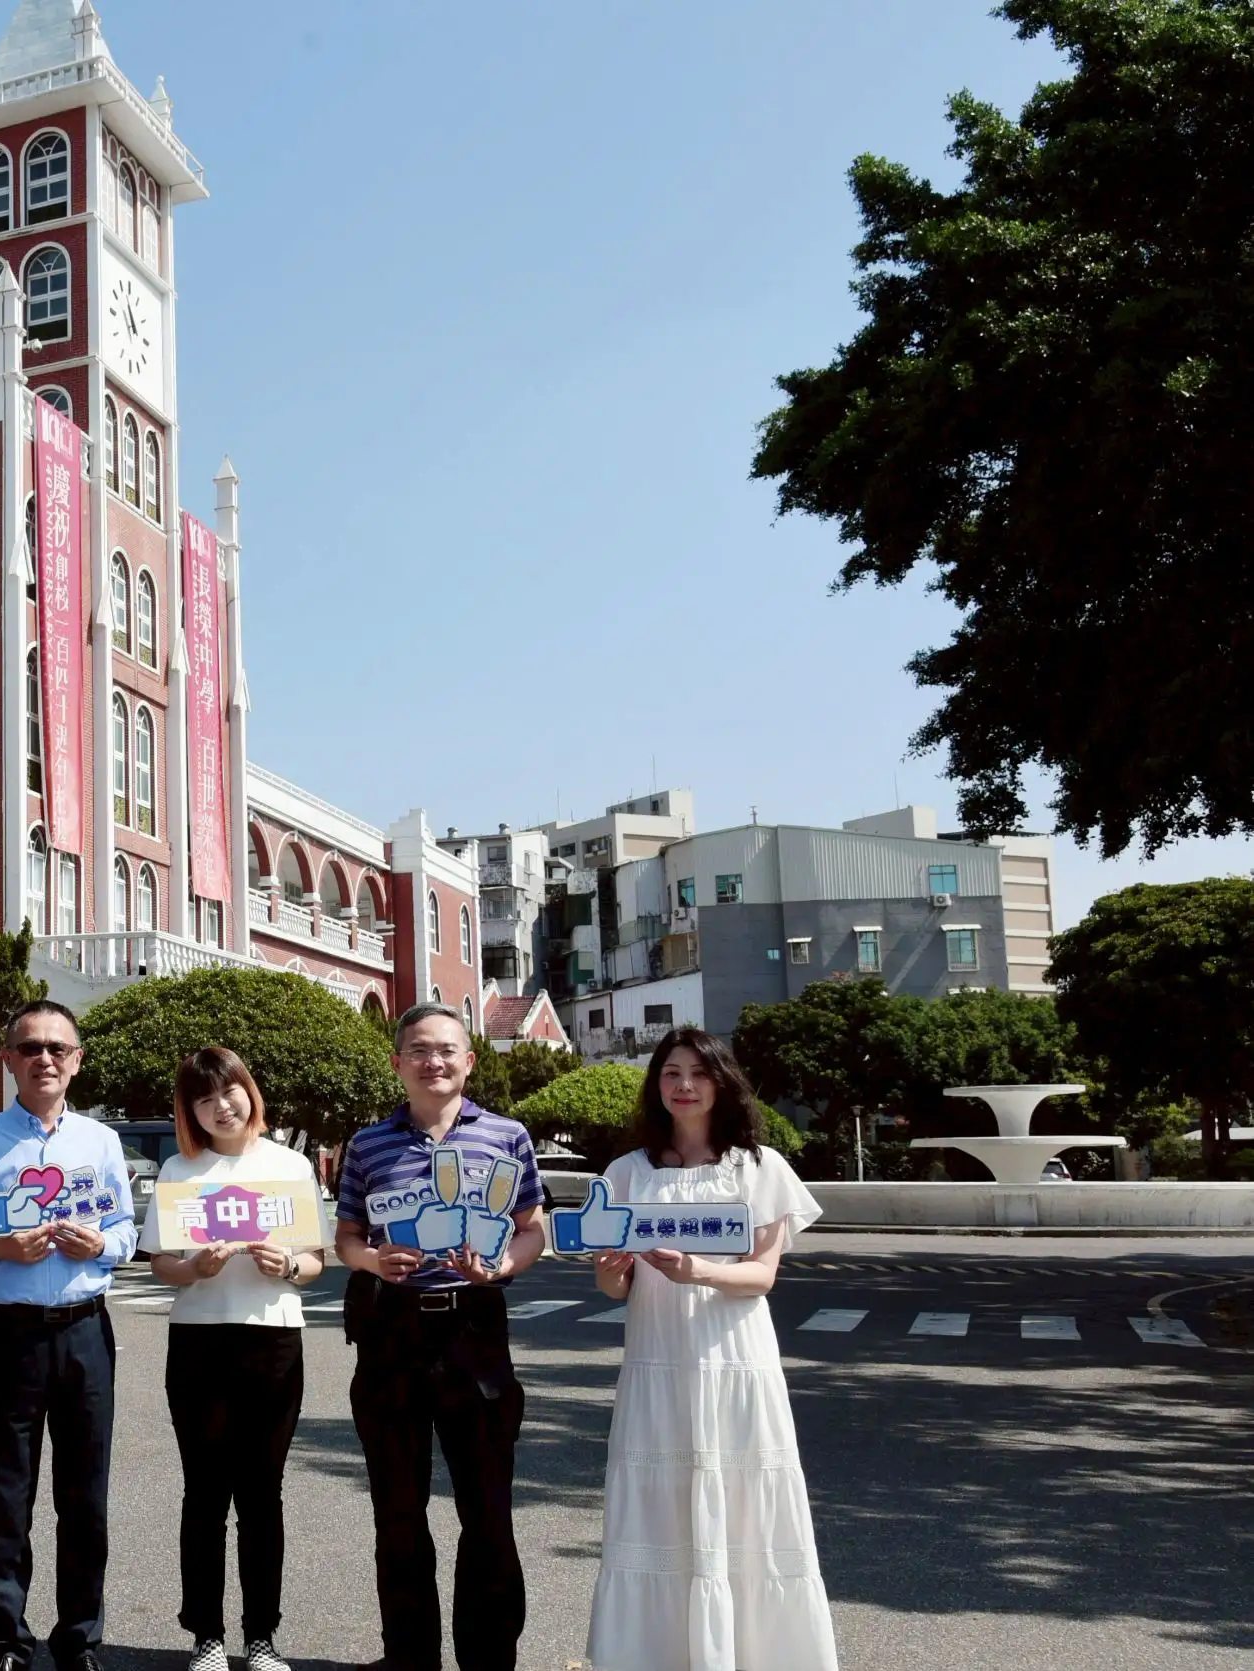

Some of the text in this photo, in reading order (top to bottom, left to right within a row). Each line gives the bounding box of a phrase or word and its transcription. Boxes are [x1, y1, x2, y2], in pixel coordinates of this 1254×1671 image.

[71, 1172, 94, 1197] 我
[370, 1183, 436, 1215] Good
[174, 1196, 294, 1229] 高中部
